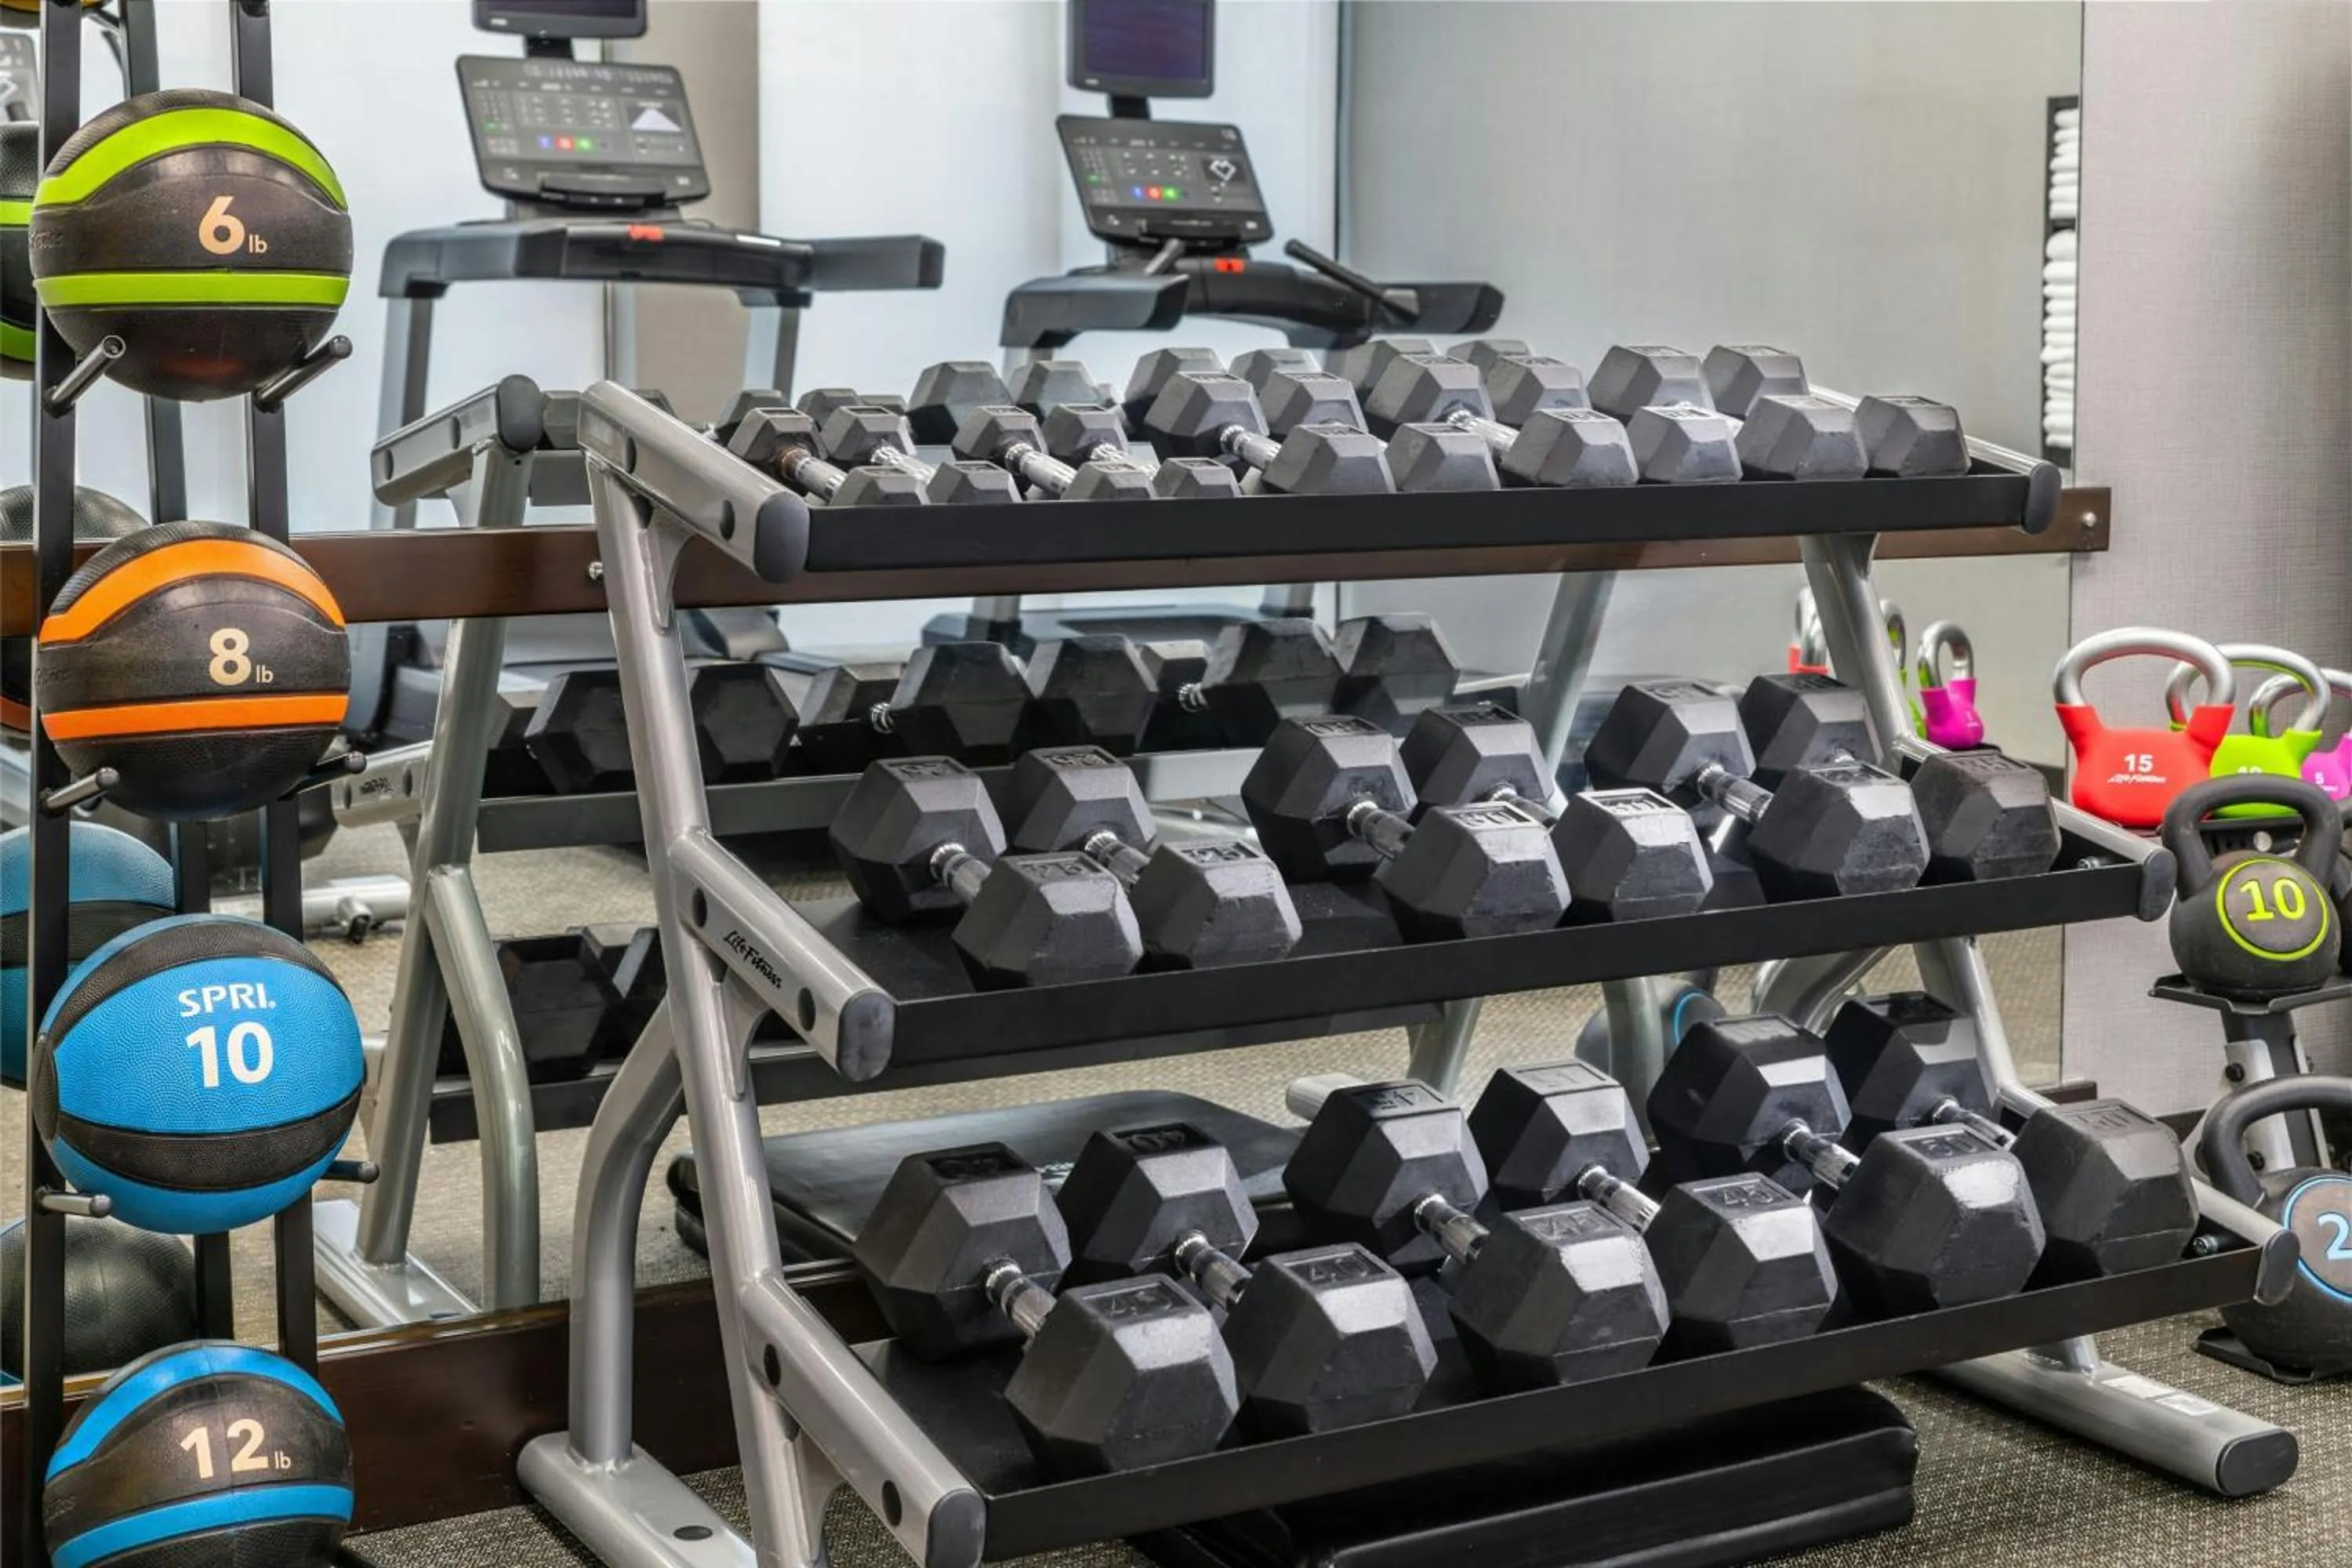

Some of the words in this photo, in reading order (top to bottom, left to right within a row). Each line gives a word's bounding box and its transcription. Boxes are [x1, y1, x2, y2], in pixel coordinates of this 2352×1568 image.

[199, 196, 245, 255] 6
[249, 234, 267, 254] lb
[209, 628, 252, 685] 8
[256, 666, 274, 684] lb
[2124, 753, 2154, 773] 15
[2240, 877, 2306, 921] 10
[185, 1022, 274, 1088] 10
[180, 1419, 269, 1480] 12
[275, 1450, 291, 1469] lb
